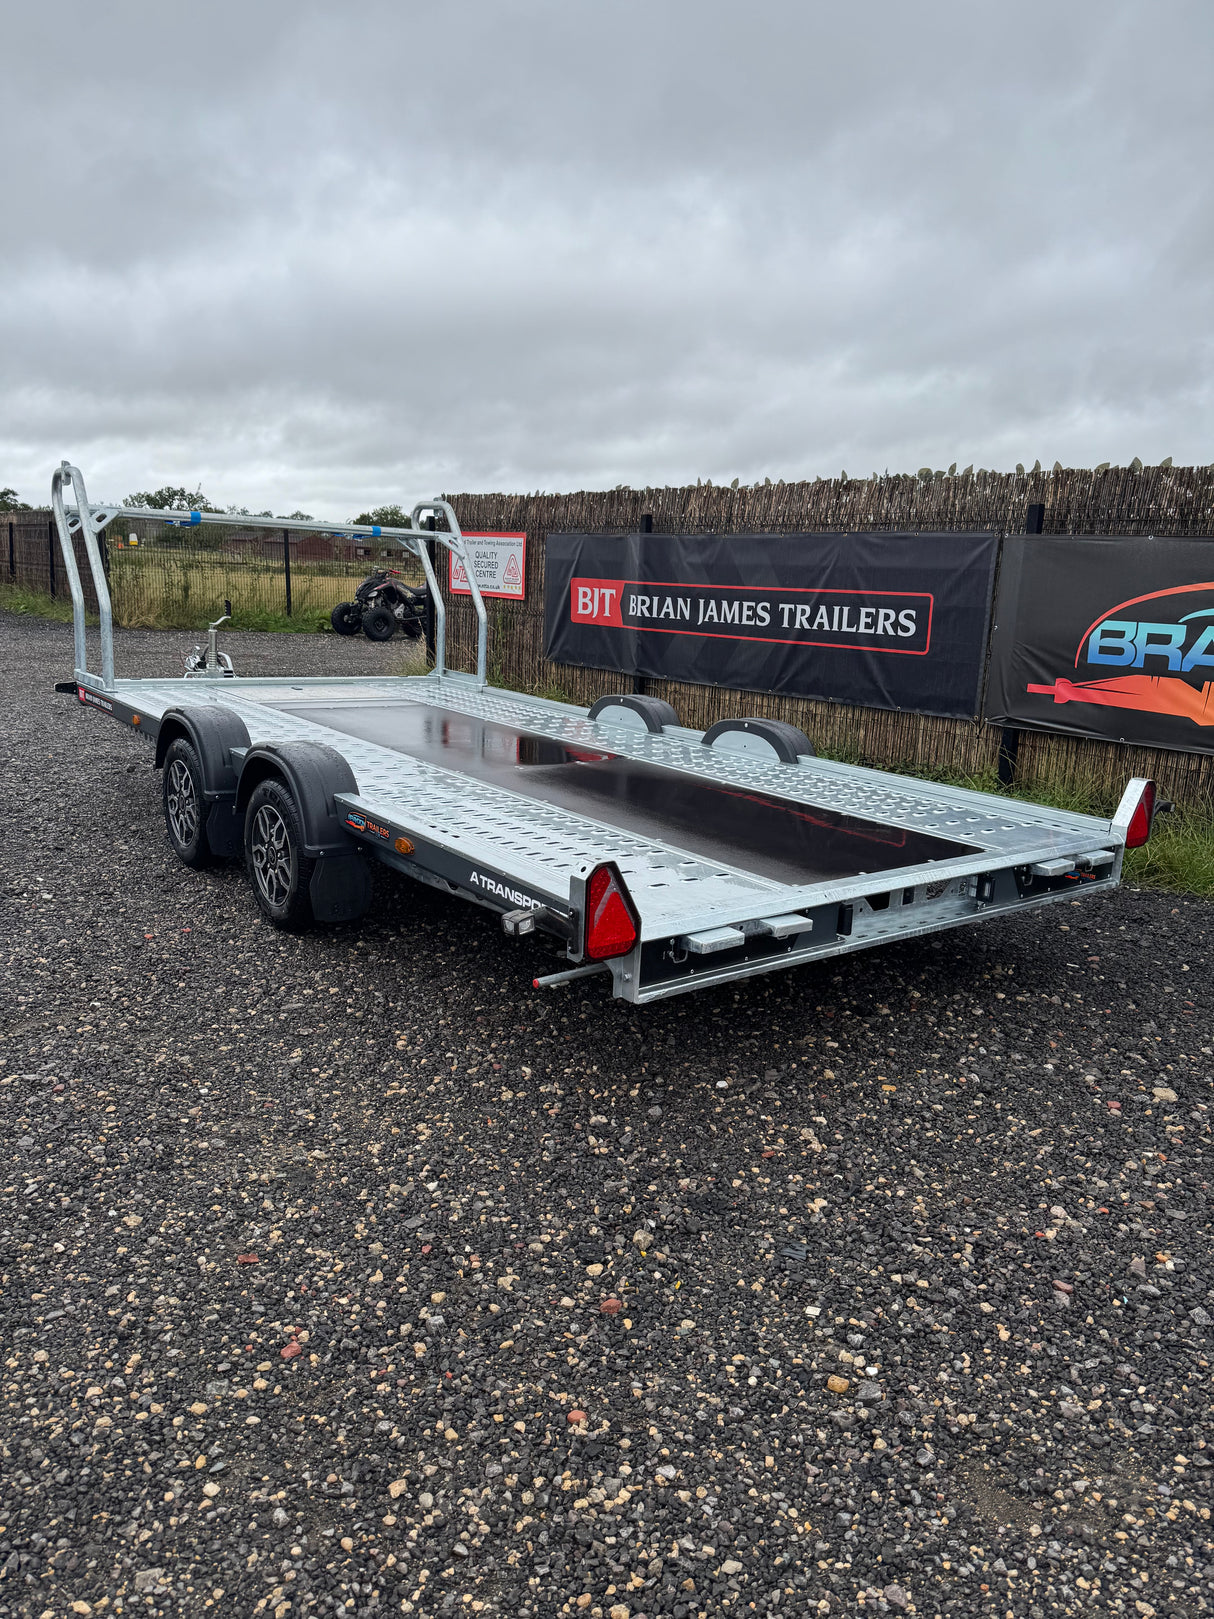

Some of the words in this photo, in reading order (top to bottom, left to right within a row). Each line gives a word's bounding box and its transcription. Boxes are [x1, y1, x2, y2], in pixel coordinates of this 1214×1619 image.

[474, 561, 499, 569] SECURED
[475, 551, 498, 559] QUALITY
[475, 570, 497, 579] CENTRE
[576, 586, 617, 619] BJT
[628, 594, 692, 621] BRIAN
[697, 598, 772, 627] JAMES
[778, 603, 917, 638] TRAILERS
[480, 875, 545, 909] TRANSPO
